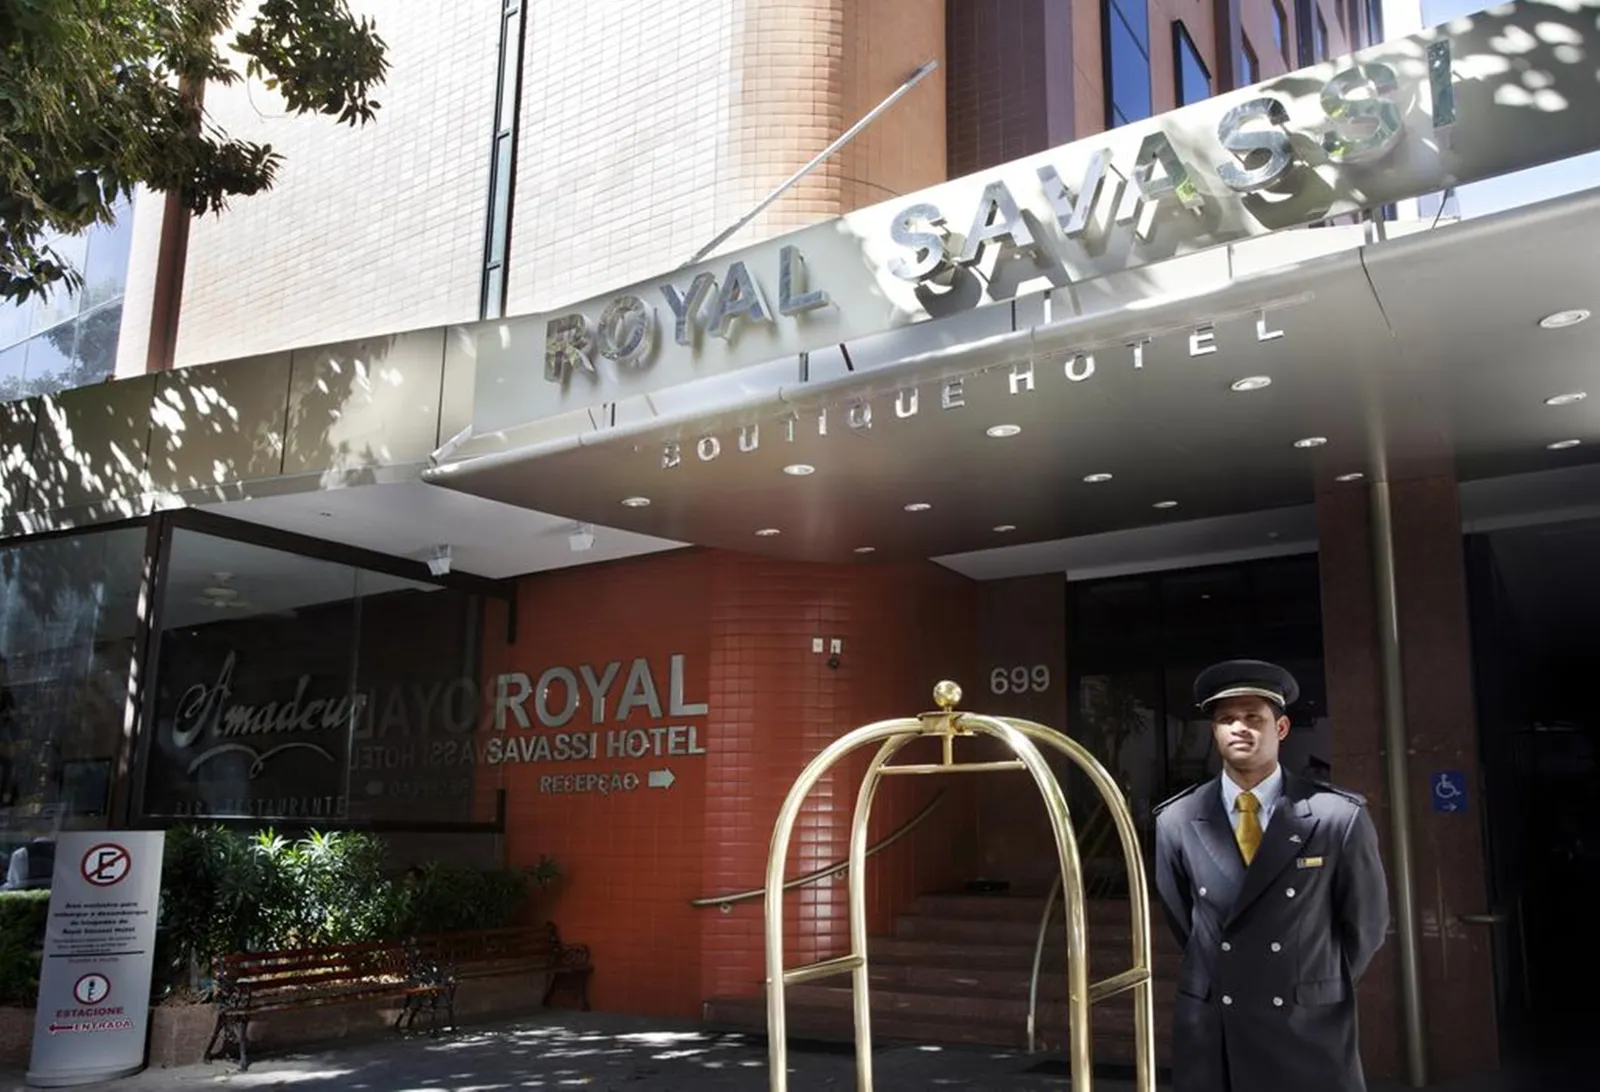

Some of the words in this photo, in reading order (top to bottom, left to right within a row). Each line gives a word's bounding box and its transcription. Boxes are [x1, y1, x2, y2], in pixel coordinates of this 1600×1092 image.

[544, 244, 830, 384] ROYAL
[887, 38, 1456, 283] SAVASSI
[662, 376, 966, 469] BOUTIQUE
[1008, 309, 1284, 395] HOTEL
[495, 654, 708, 731] ROYAL
[990, 664, 1050, 695] 699
[487, 731, 598, 765] SAVASSI
[606, 725, 707, 758] HOTEL
[56, 1006, 124, 1018] ESTACIONE
[73, 1018, 133, 1031] ENTRADA
